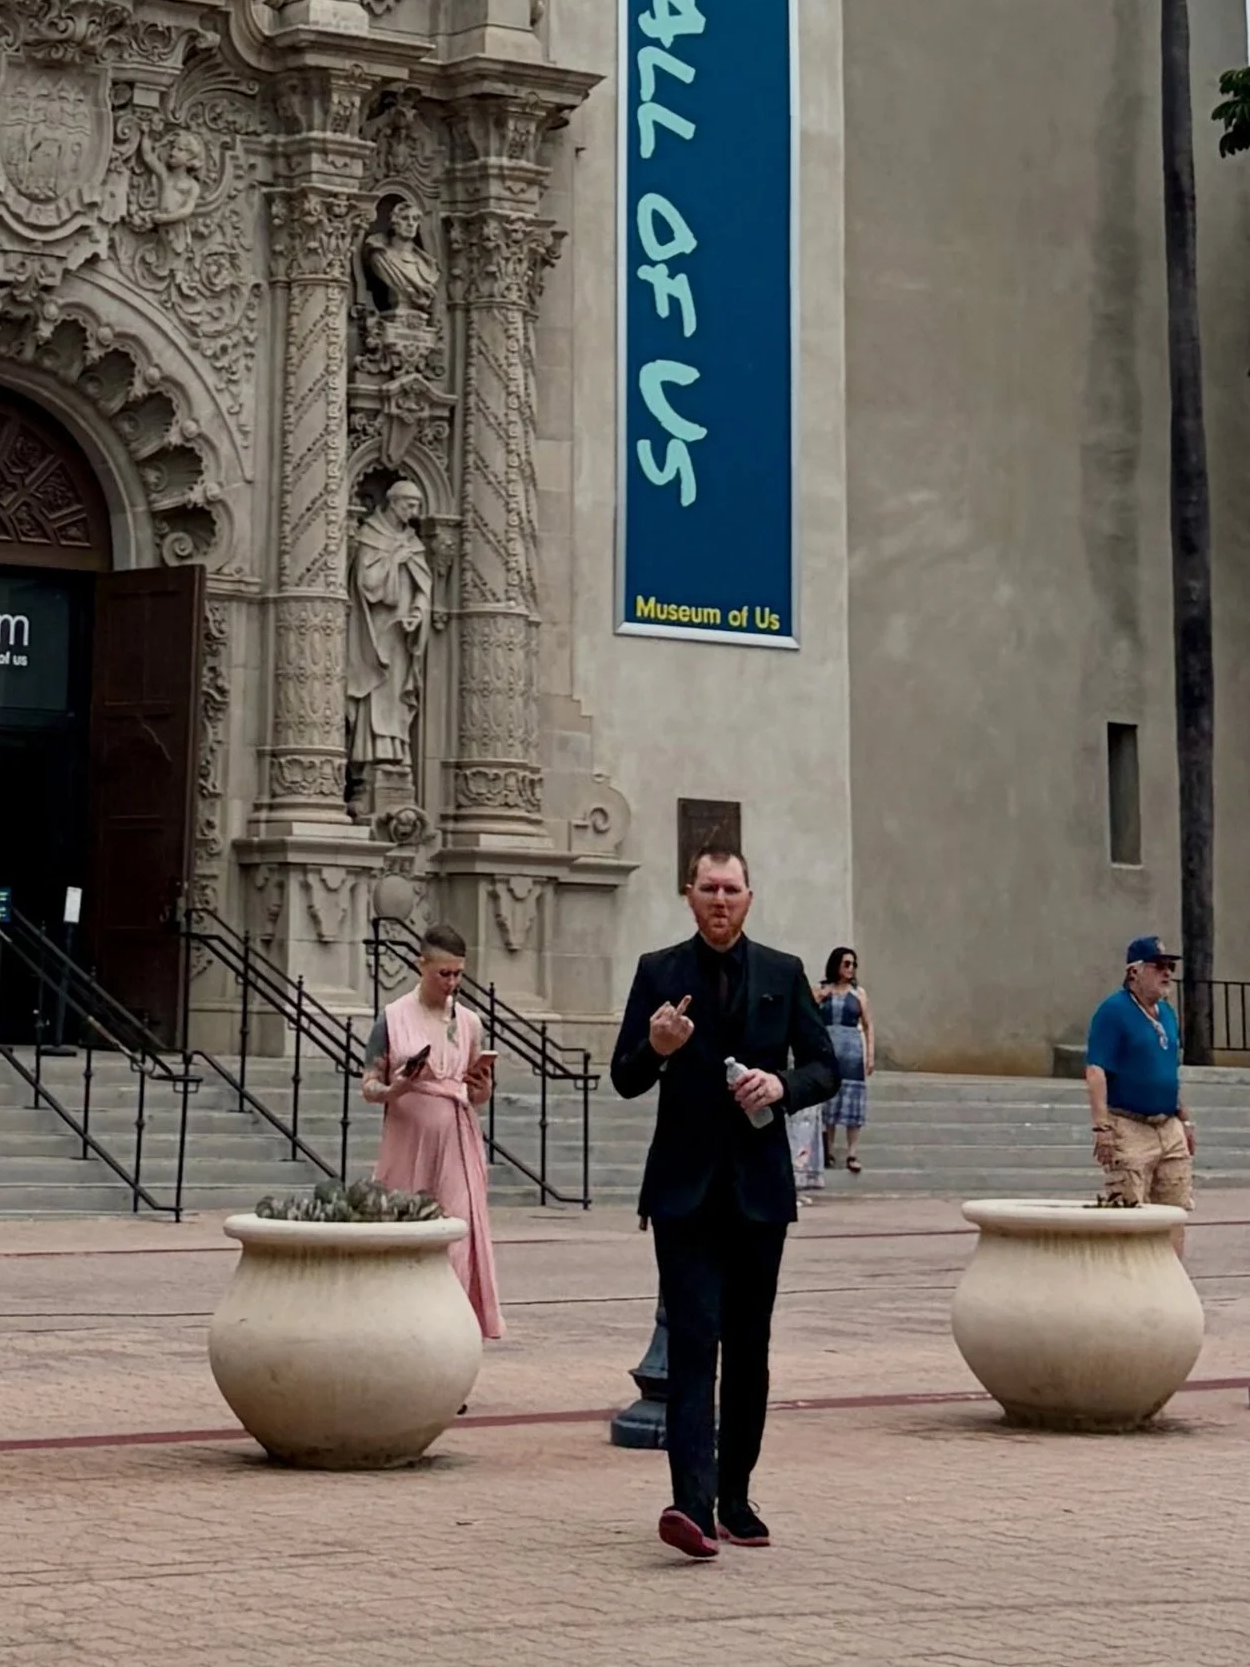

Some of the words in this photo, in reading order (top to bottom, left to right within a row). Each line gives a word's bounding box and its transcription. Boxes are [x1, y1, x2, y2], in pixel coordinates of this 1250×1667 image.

[636, 192, 697, 338] OF
[636, 359, 707, 507] US
[635, 594, 722, 626] Museum
[728, 605, 749, 628] of
[754, 606, 781, 631] Us
[12, 654, 28, 667] us
